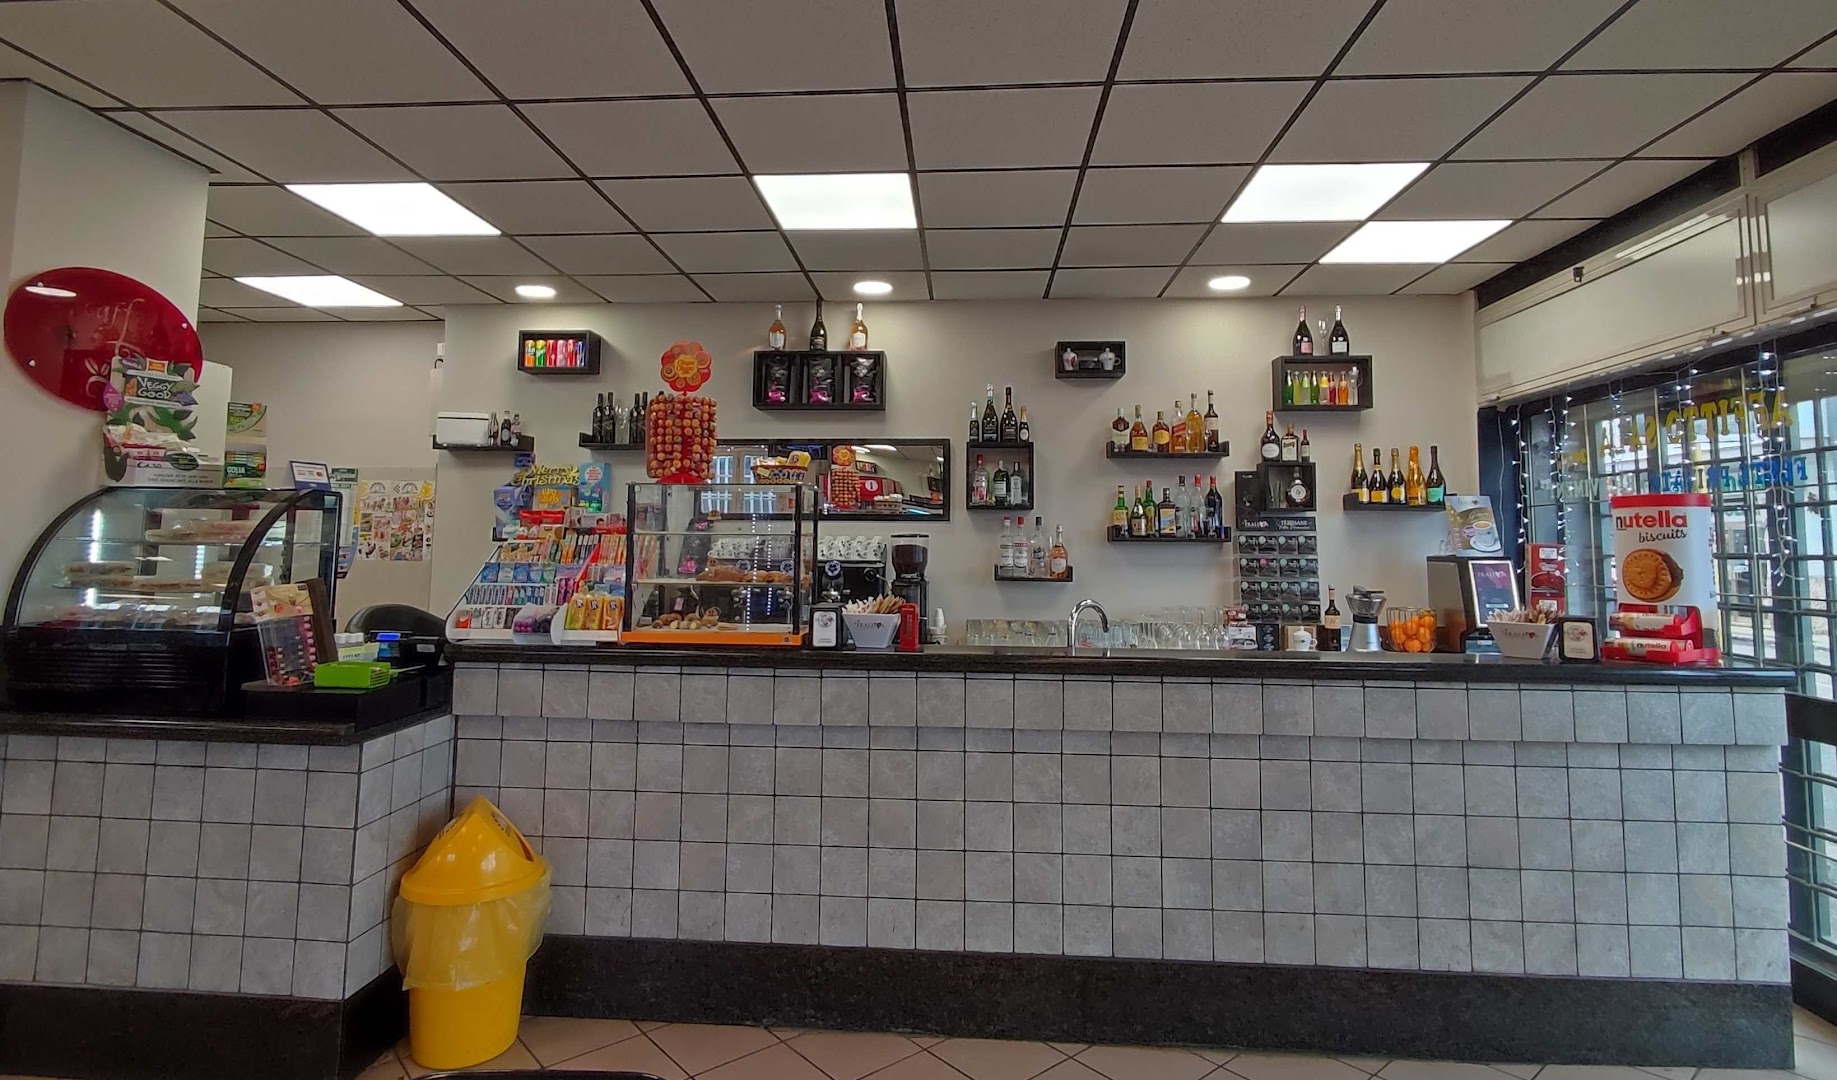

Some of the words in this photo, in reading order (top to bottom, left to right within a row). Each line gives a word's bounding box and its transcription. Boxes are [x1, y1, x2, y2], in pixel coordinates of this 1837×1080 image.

[137, 376, 175, 391] VEGGY
[138, 387, 171, 399] GOOD
[1615, 510, 1688, 530] nutella
[1638, 528, 1688, 543] biscuits
